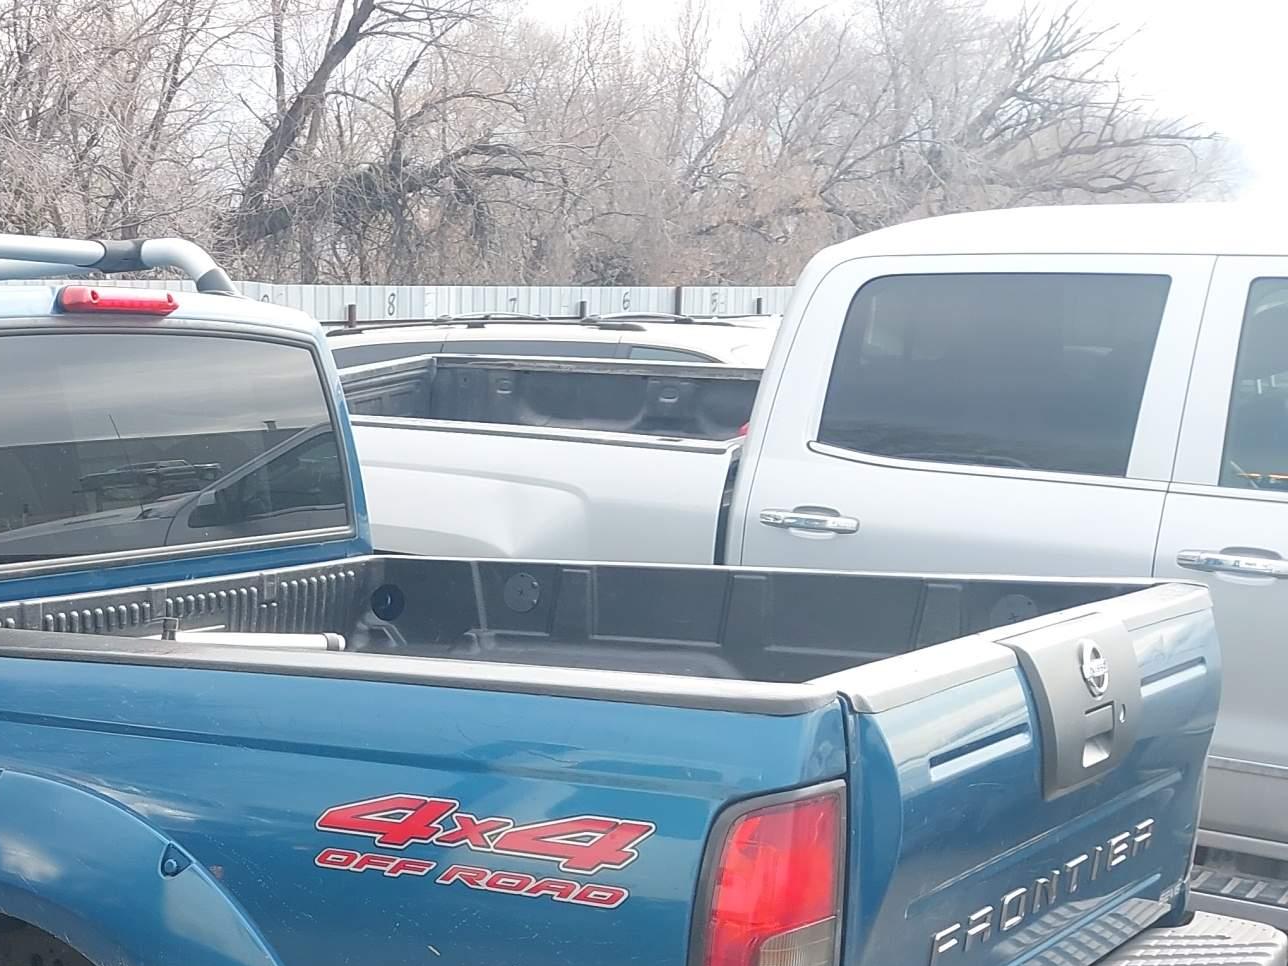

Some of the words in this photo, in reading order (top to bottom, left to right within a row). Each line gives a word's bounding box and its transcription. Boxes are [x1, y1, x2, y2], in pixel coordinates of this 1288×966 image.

[387, 292, 397, 316] 8
[622, 291, 631, 312] 6
[314, 847, 438, 878] OFF
[434, 864, 630, 910] ROAD
